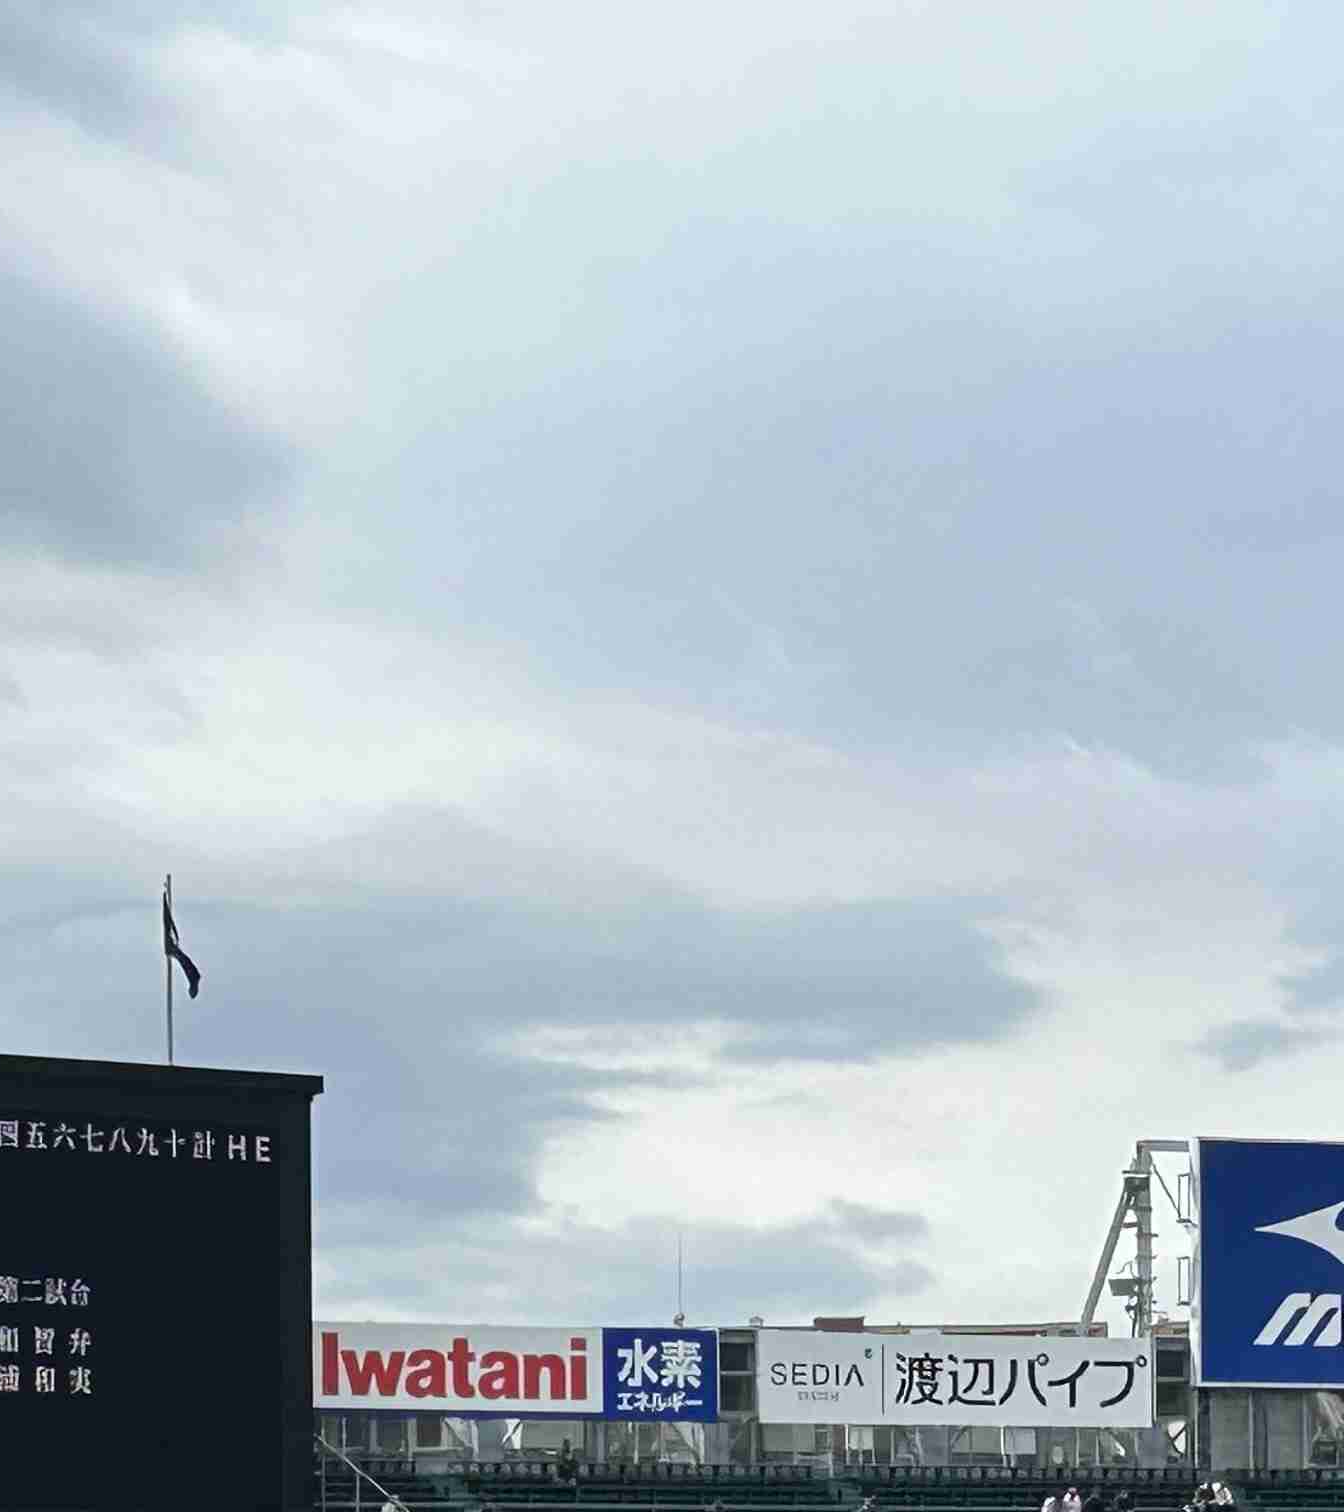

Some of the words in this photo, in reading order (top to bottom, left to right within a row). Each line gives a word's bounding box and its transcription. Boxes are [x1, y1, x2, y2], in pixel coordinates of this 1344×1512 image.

[228, 1134, 247, 1161] H
[255, 1135, 271, 1163] E
[321, 1331, 588, 1401] Iwatani
[616, 1338, 702, 1389] 水素
[770, 1362, 865, 1388] SEDIA
[895, 1352, 1148, 1409] 渡辺パイプ
[616, 1391, 703, 1413] エネルギー
